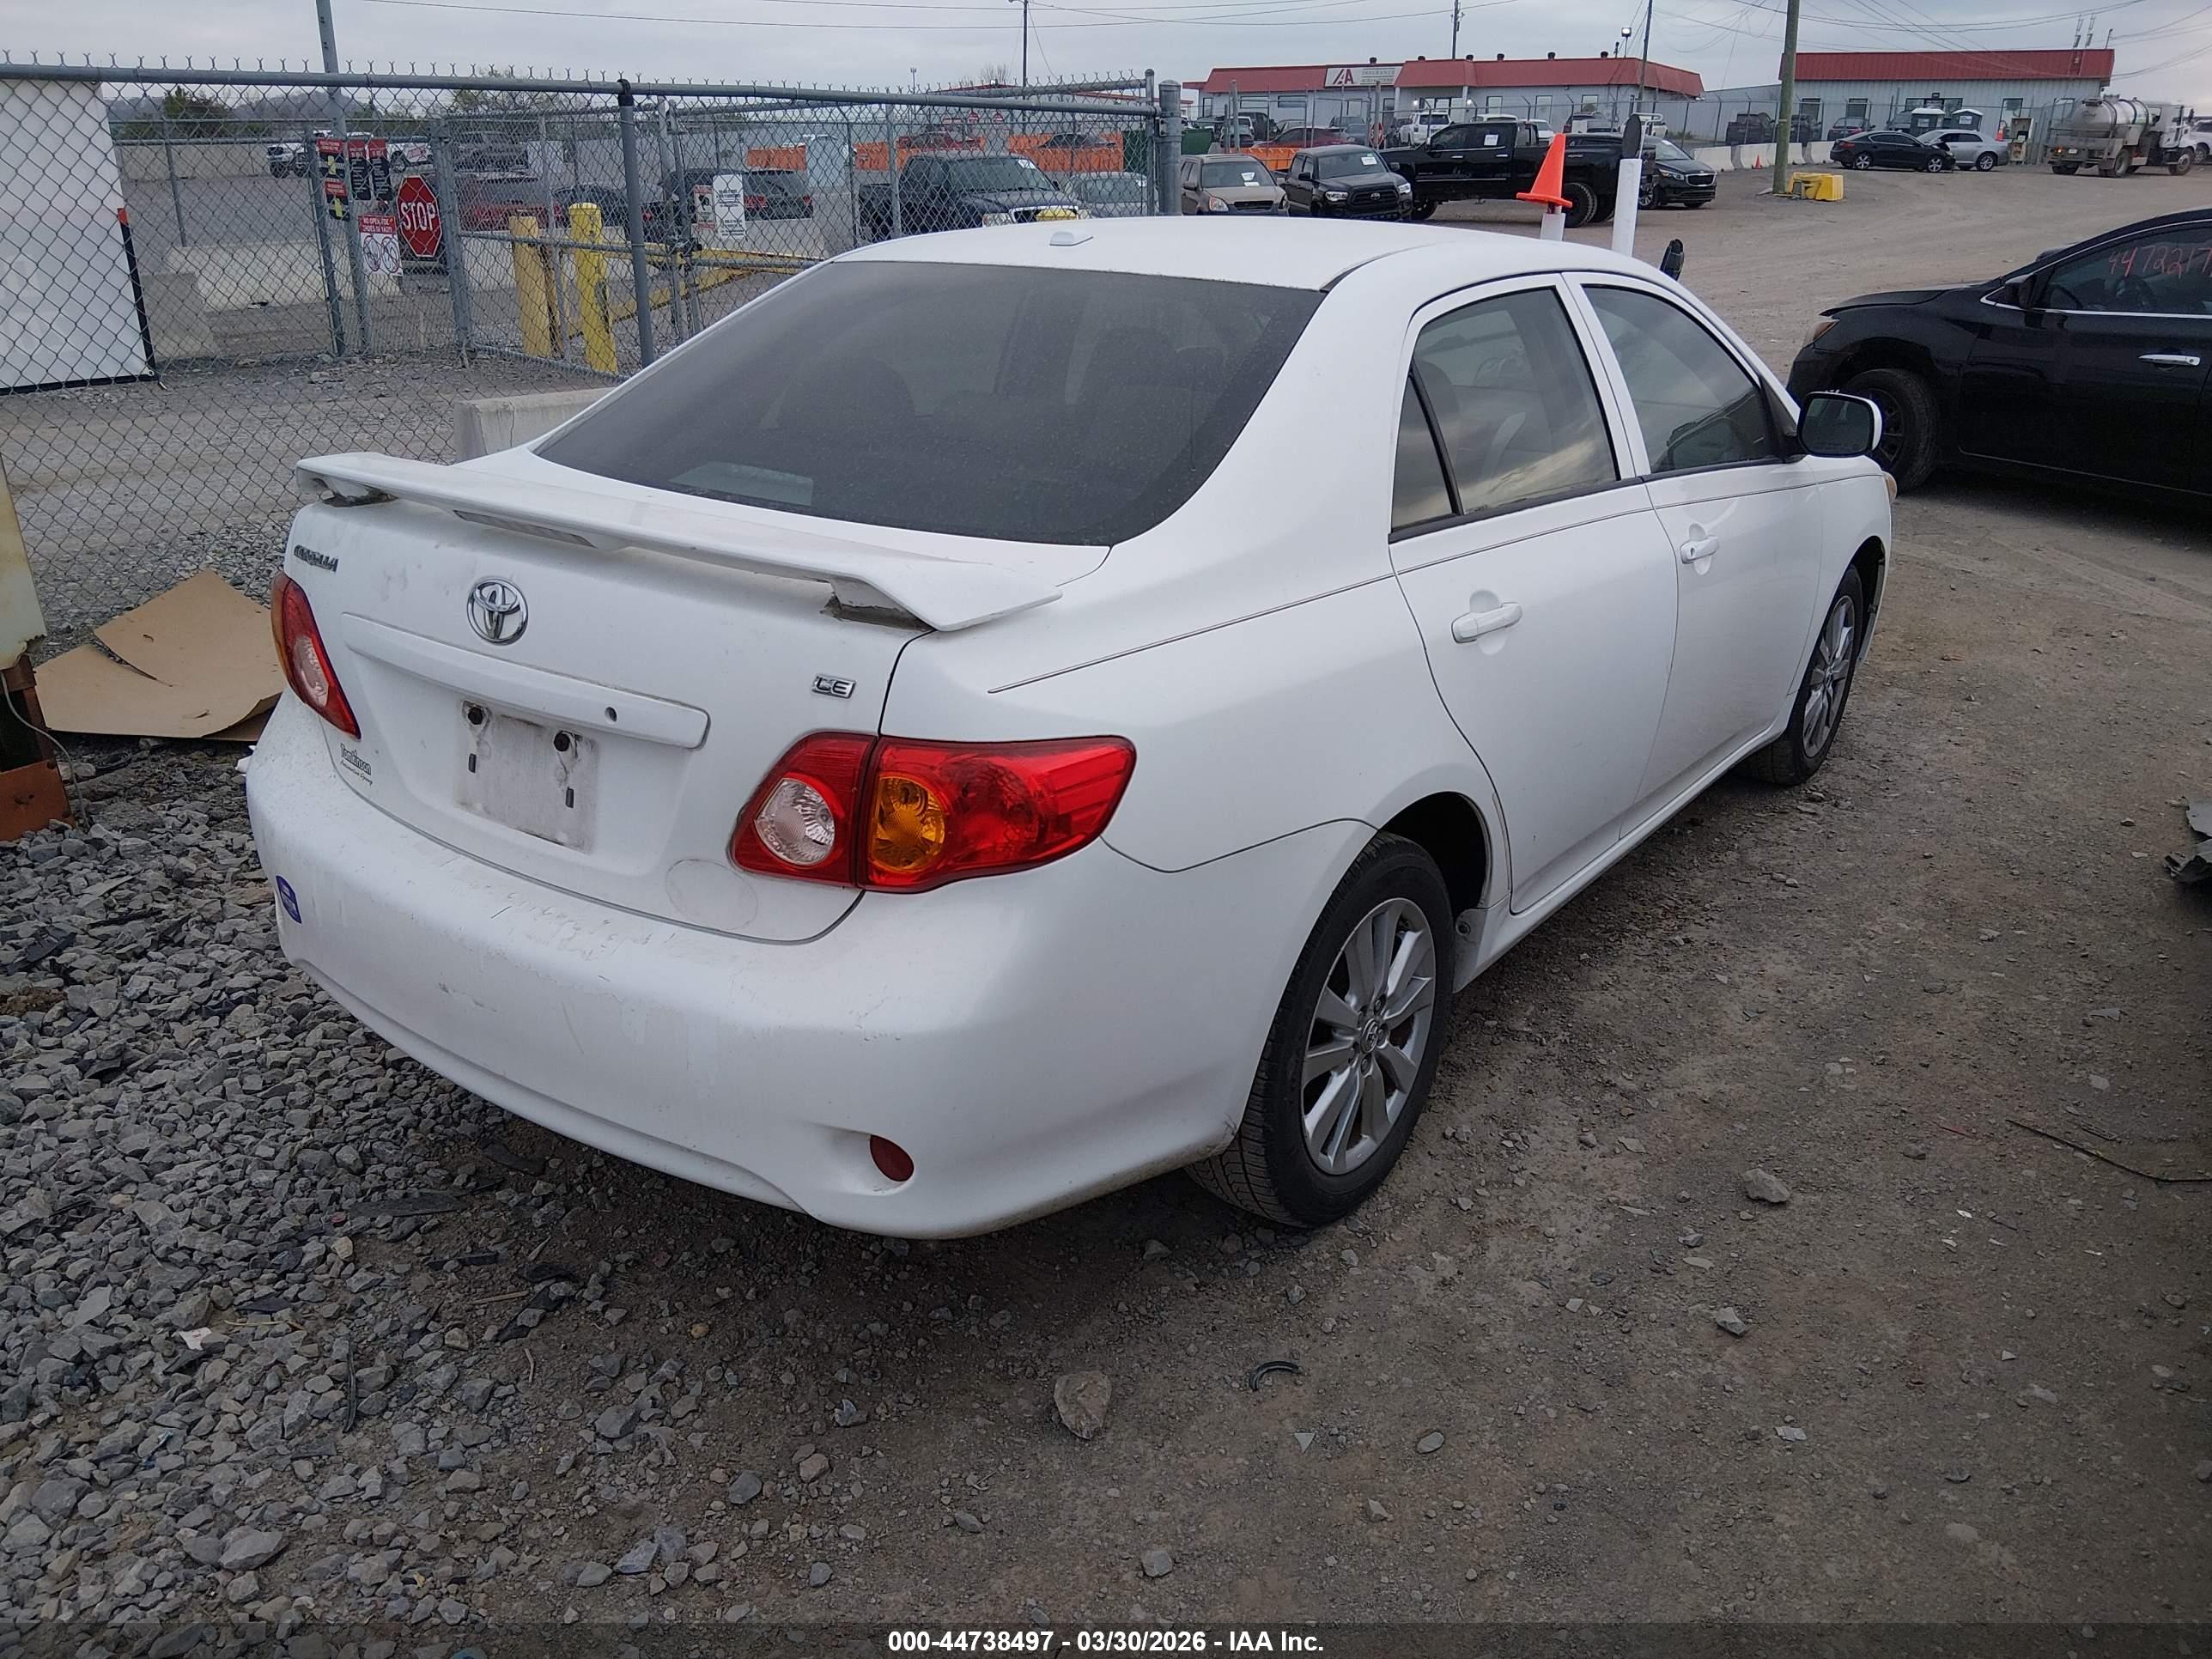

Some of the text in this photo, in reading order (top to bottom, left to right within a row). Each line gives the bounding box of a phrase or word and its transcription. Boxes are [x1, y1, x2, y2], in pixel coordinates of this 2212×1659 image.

[400, 202, 436, 231] STOP
[2109, 246, 2212, 279] 4472217
[813, 676, 855, 698] LE
